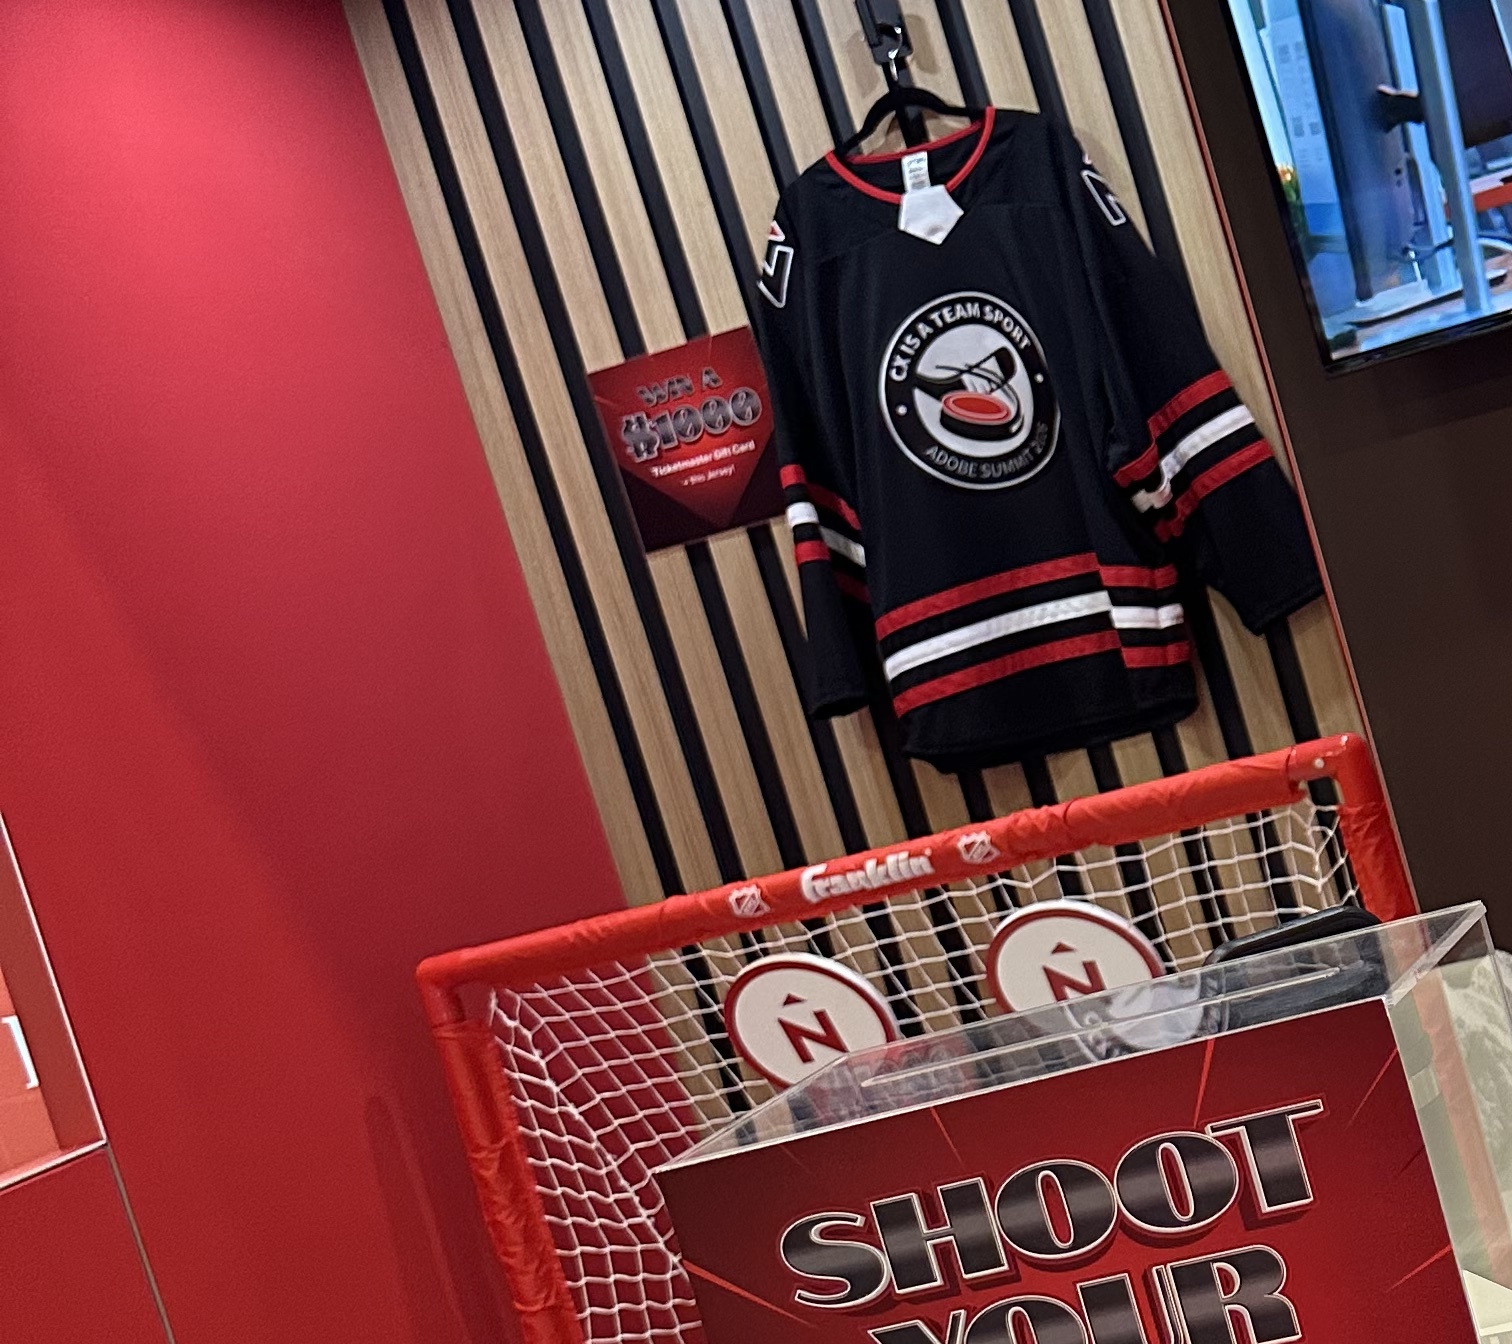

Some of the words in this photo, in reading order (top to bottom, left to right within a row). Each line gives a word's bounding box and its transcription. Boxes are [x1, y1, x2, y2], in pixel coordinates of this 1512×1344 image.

[889, 354, 911, 383] CX
[900, 334, 922, 356] IS
[915, 320, 935, 339] A
[929, 301, 981, 329] TEAM
[983, 304, 1032, 350] SPORT
[702, 366, 724, 391] A
[926, 445, 978, 477] ADOBE
[801, 850, 936, 904] Franklin
[779, 1100, 1324, 1310] SHOOT
